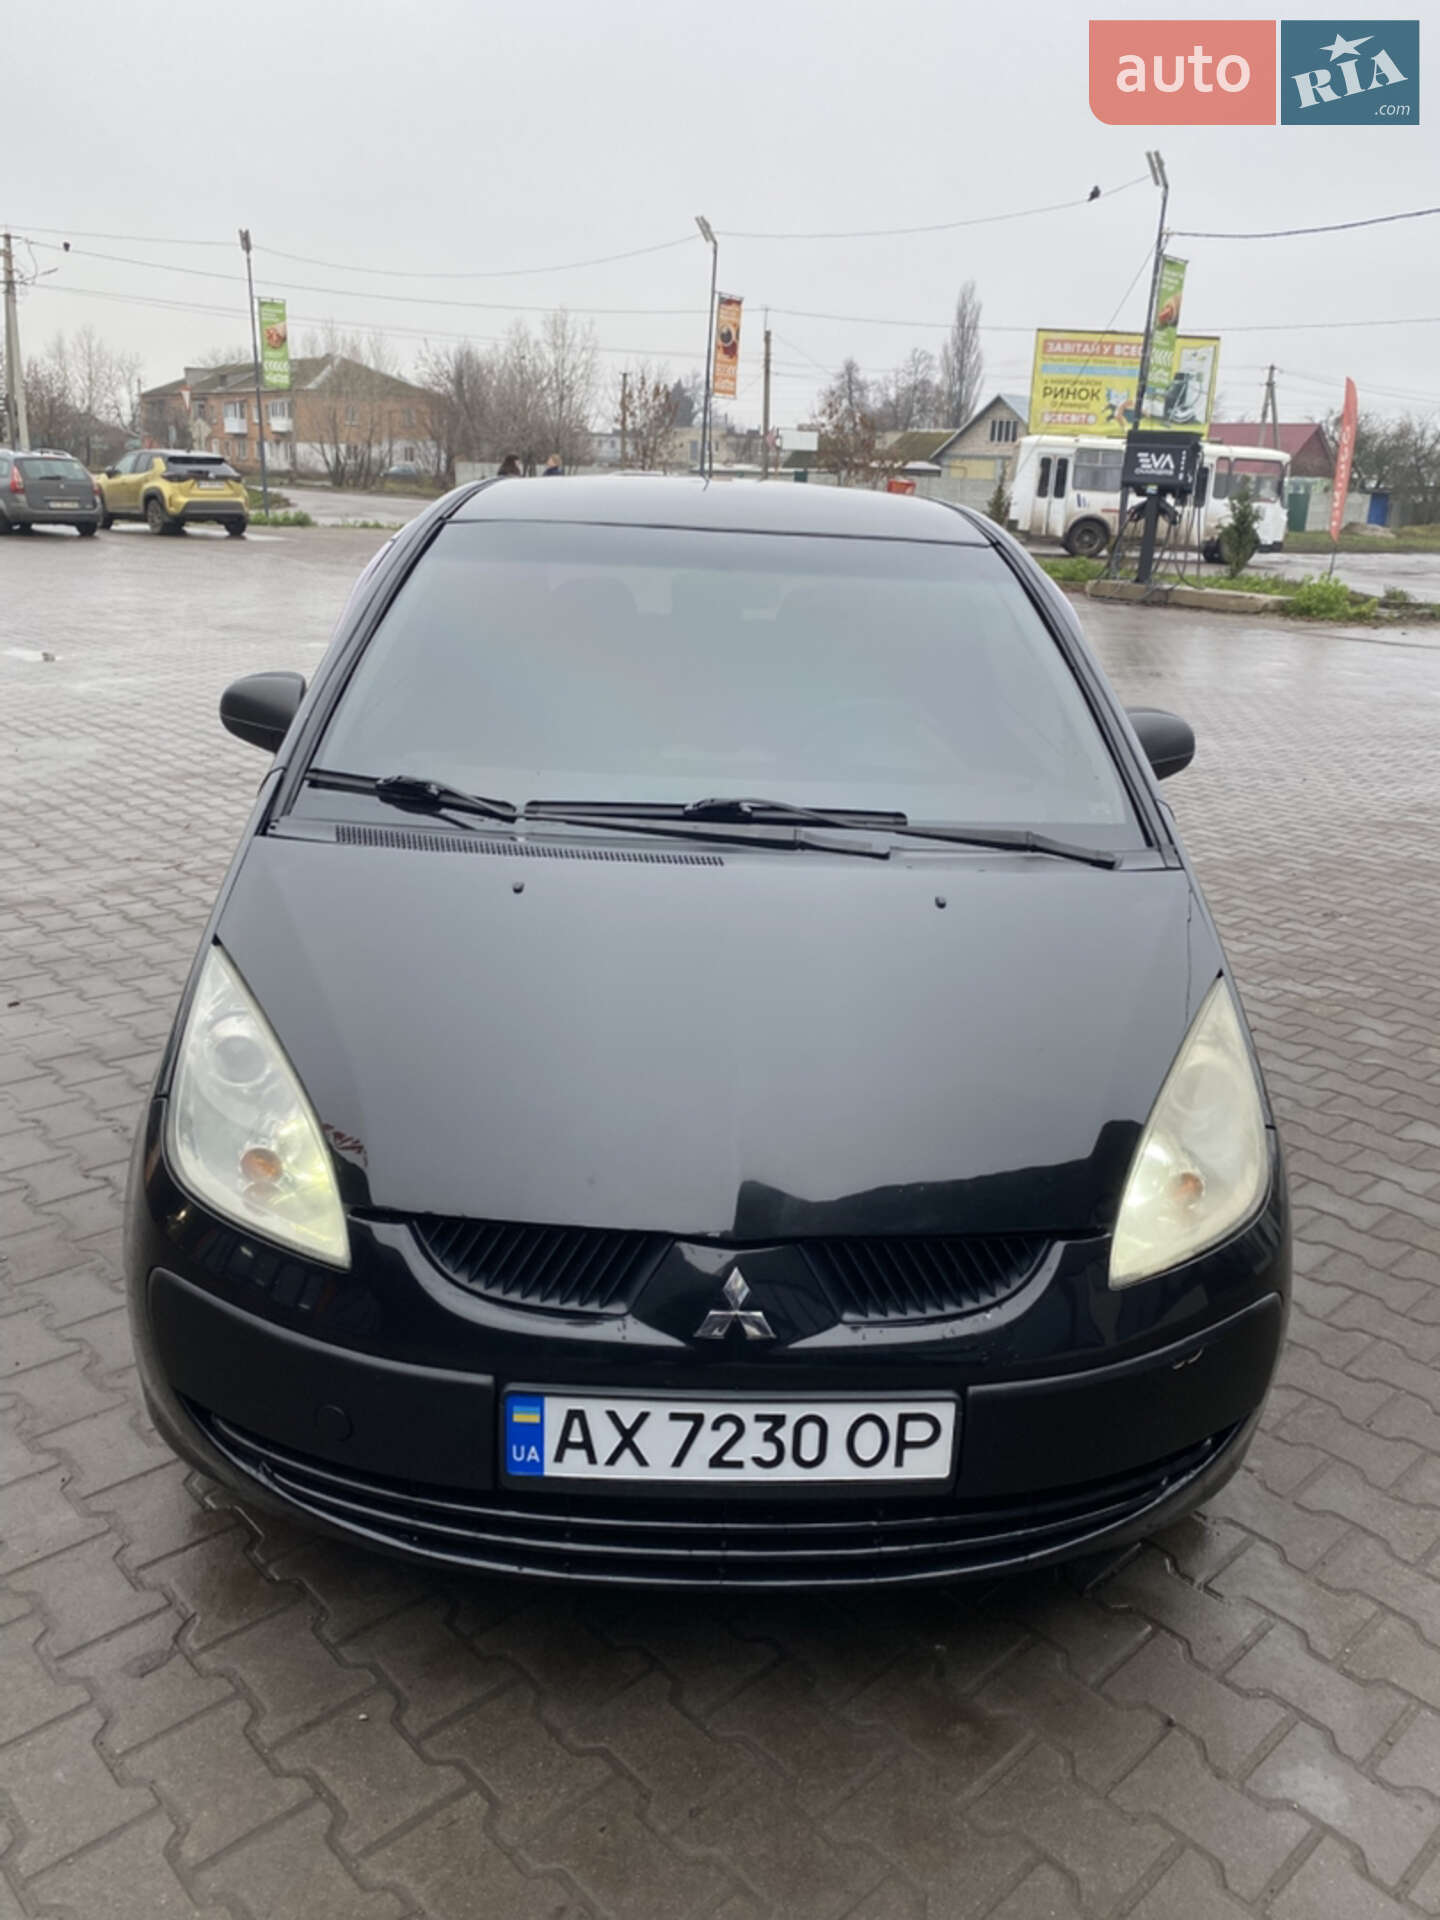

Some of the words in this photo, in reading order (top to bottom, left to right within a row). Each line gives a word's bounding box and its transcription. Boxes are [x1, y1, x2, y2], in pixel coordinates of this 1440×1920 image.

[1042, 386, 1101, 400] РИНОК
[1136, 452, 1175, 470] EVA
[512, 1445, 540, 1463] UA
[553, 1408, 651, 1468] AX
[668, 1412, 828, 1470] 7230
[845, 1412, 942, 1468] OP
